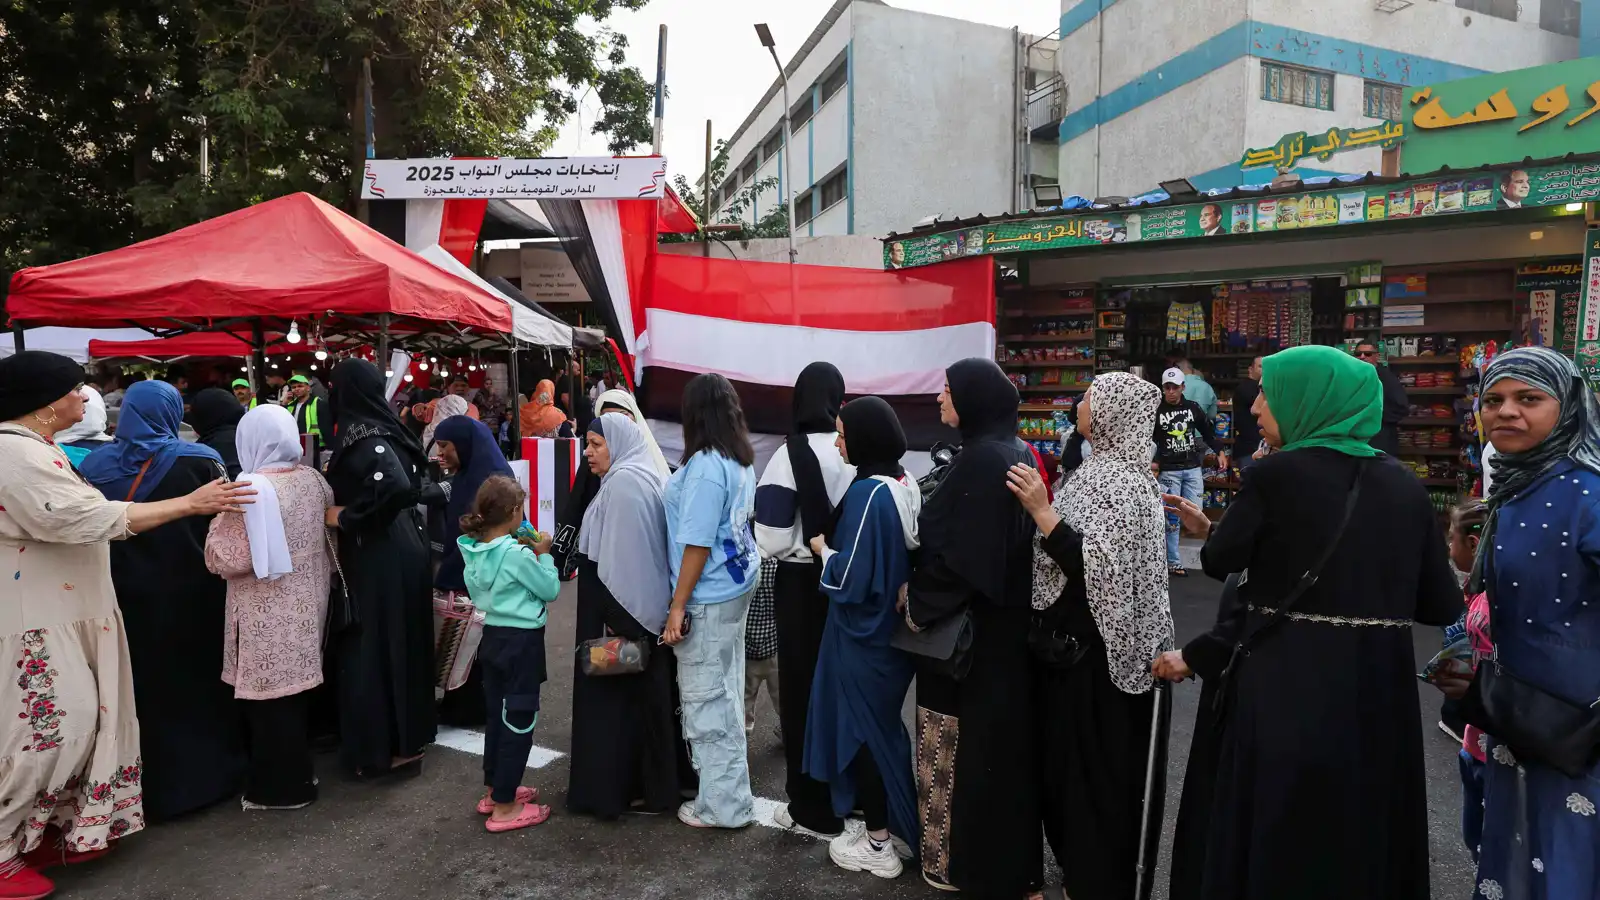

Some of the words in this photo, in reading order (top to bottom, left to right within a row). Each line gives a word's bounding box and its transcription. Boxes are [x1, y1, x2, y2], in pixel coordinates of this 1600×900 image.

[405, 166, 455, 182] 2025
[459, 165, 502, 181] النواب
[504, 165, 552, 181] مجلس
[1538, 170, 1570, 181] مصر
[1538, 181, 1569, 192] مصر
[1570, 176, 1600, 188] تحيا
[423, 186, 466, 199] بالعجوزة
[467, 187, 488, 199] بنين
[496, 185, 519, 197] بنات
[521, 184, 559, 197] القومية
[561, 184, 596, 196] المدارس
[1570, 188, 1600, 200] تحيا
[1536, 193, 1569, 204] مصر
[1143, 212, 1165, 222] مصر
[986, 220, 1082, 244] المحروسة
[1143, 222, 1164, 231] مصر
[1142, 232, 1164, 240] مصر
